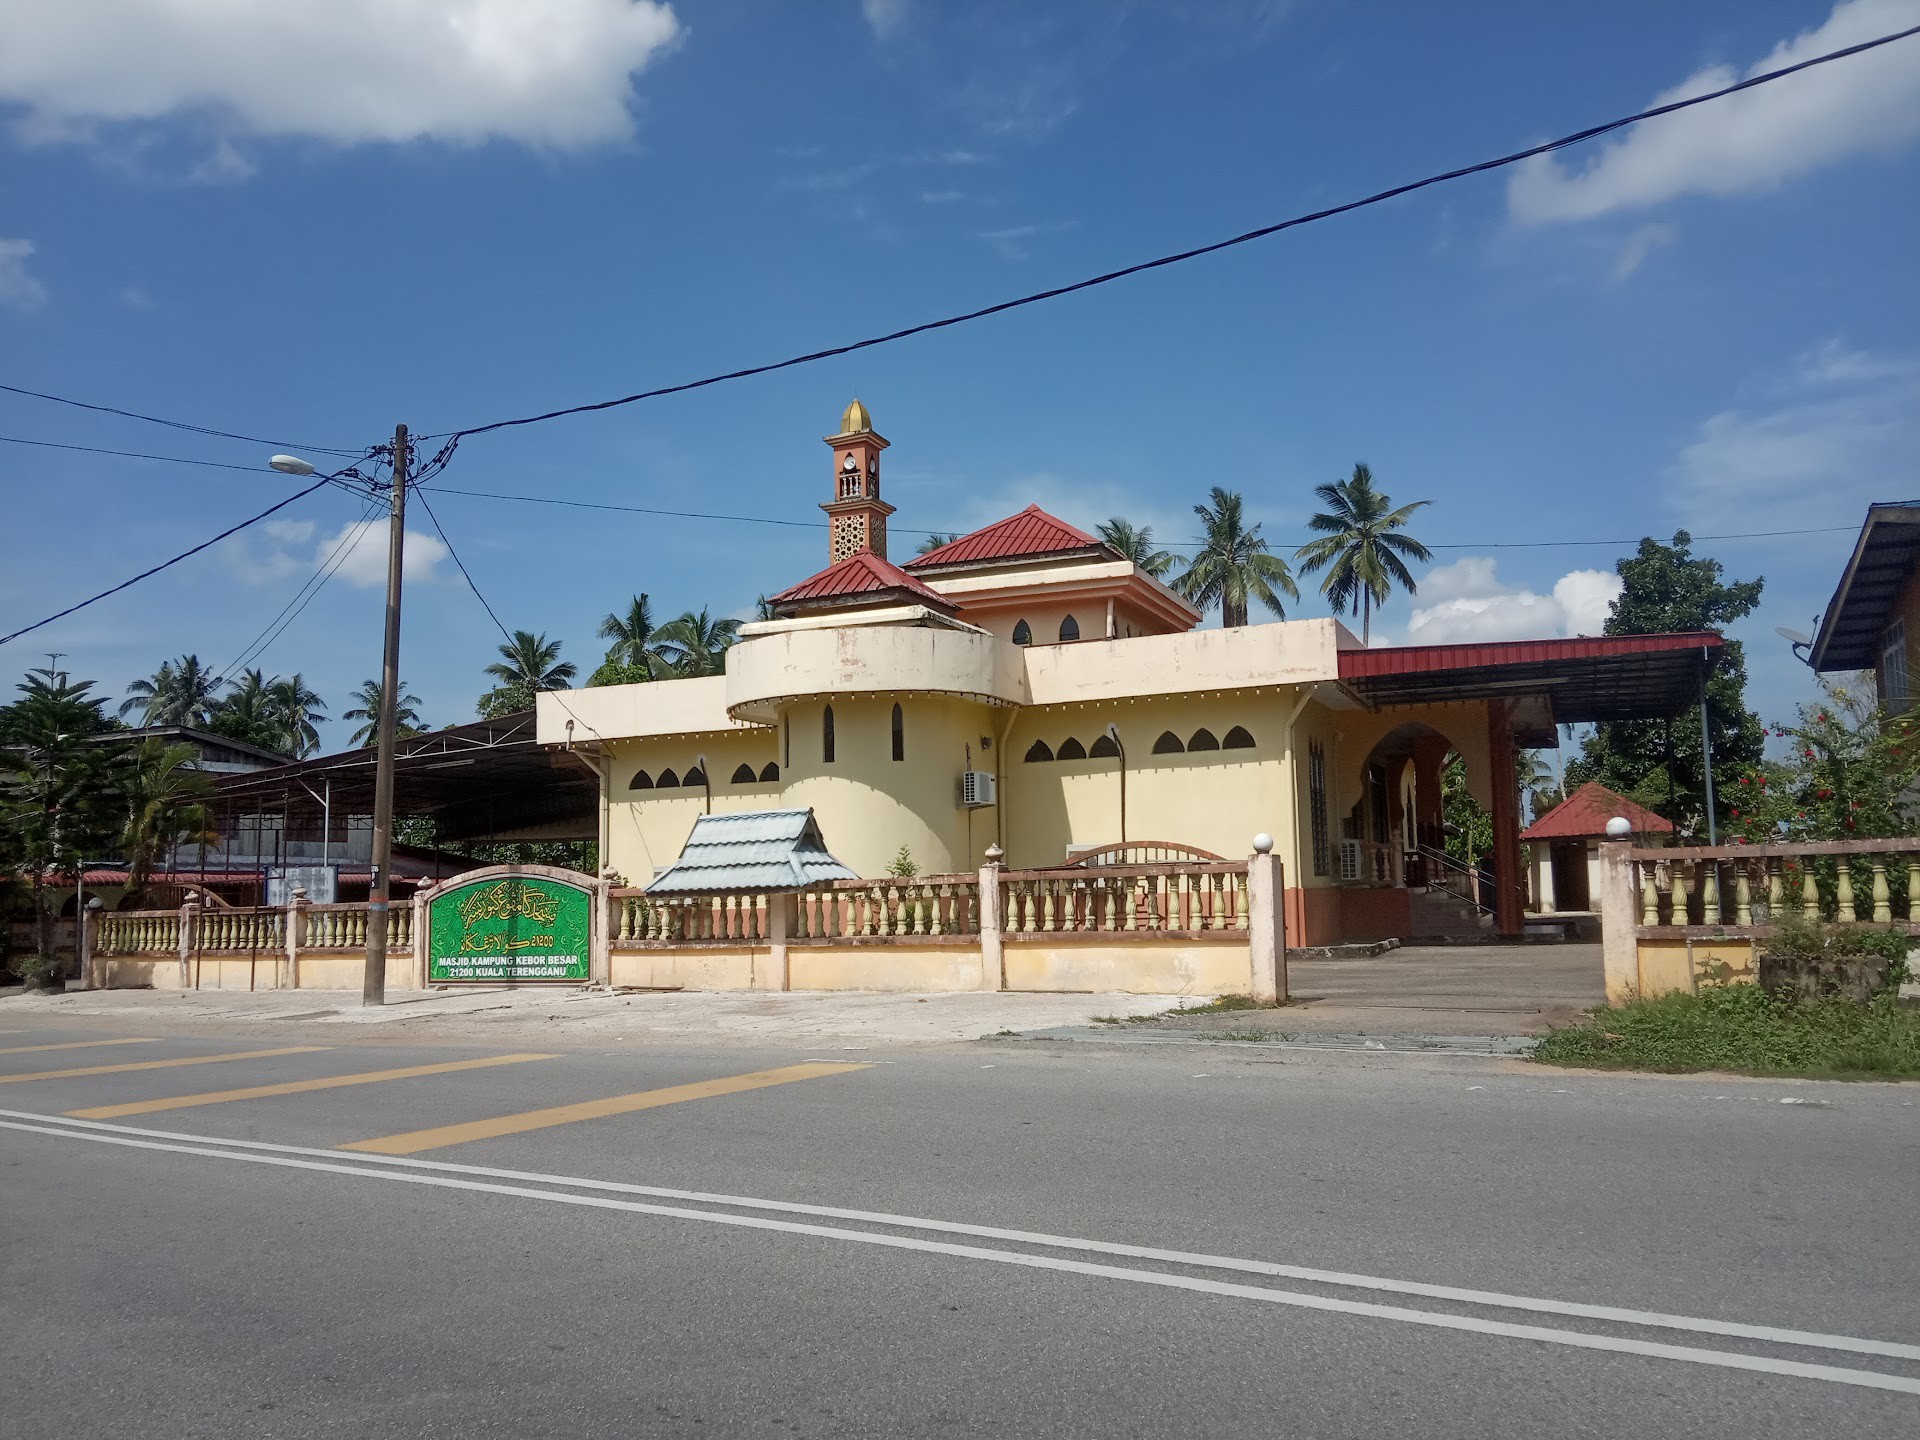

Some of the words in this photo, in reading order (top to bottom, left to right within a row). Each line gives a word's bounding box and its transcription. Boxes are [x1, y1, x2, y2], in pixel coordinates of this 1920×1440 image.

[531, 935, 554, 948] 21200
[439, 957, 469, 966] MASJID
[471, 956, 514, 966] KAMPUNG
[515, 955, 546, 965] KEBOR
[547, 955, 578, 965] BESAR
[449, 967, 474, 977] 21200
[475, 967, 505, 977] KUALA
[505, 966, 567, 977] TERENGGANU
